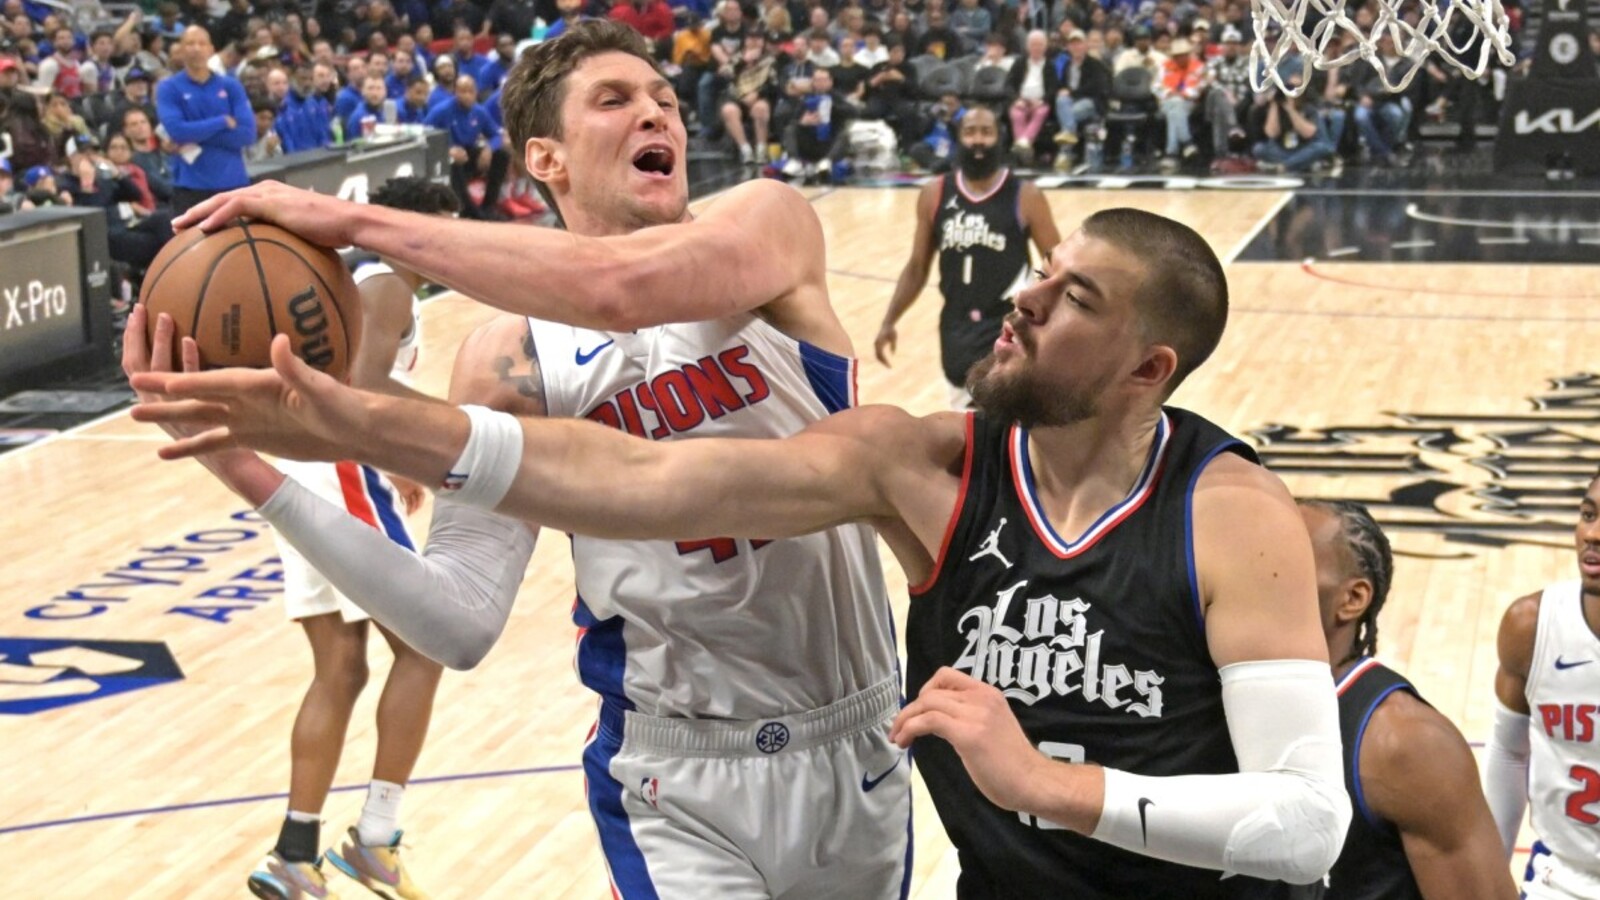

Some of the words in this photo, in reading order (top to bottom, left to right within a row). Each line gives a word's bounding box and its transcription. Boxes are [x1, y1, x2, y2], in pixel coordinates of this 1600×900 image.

[941, 218, 1007, 252] Angeles
[954, 210, 985, 231] Los
[963, 255, 973, 285] 1
[4, 280, 66, 329] X-Pro
[162, 556, 284, 624] ARE
[992, 579, 1091, 648] Los
[952, 605, 1165, 718] Angeles
[1537, 704, 1600, 743] PIS
[1564, 764, 1600, 825] 2
